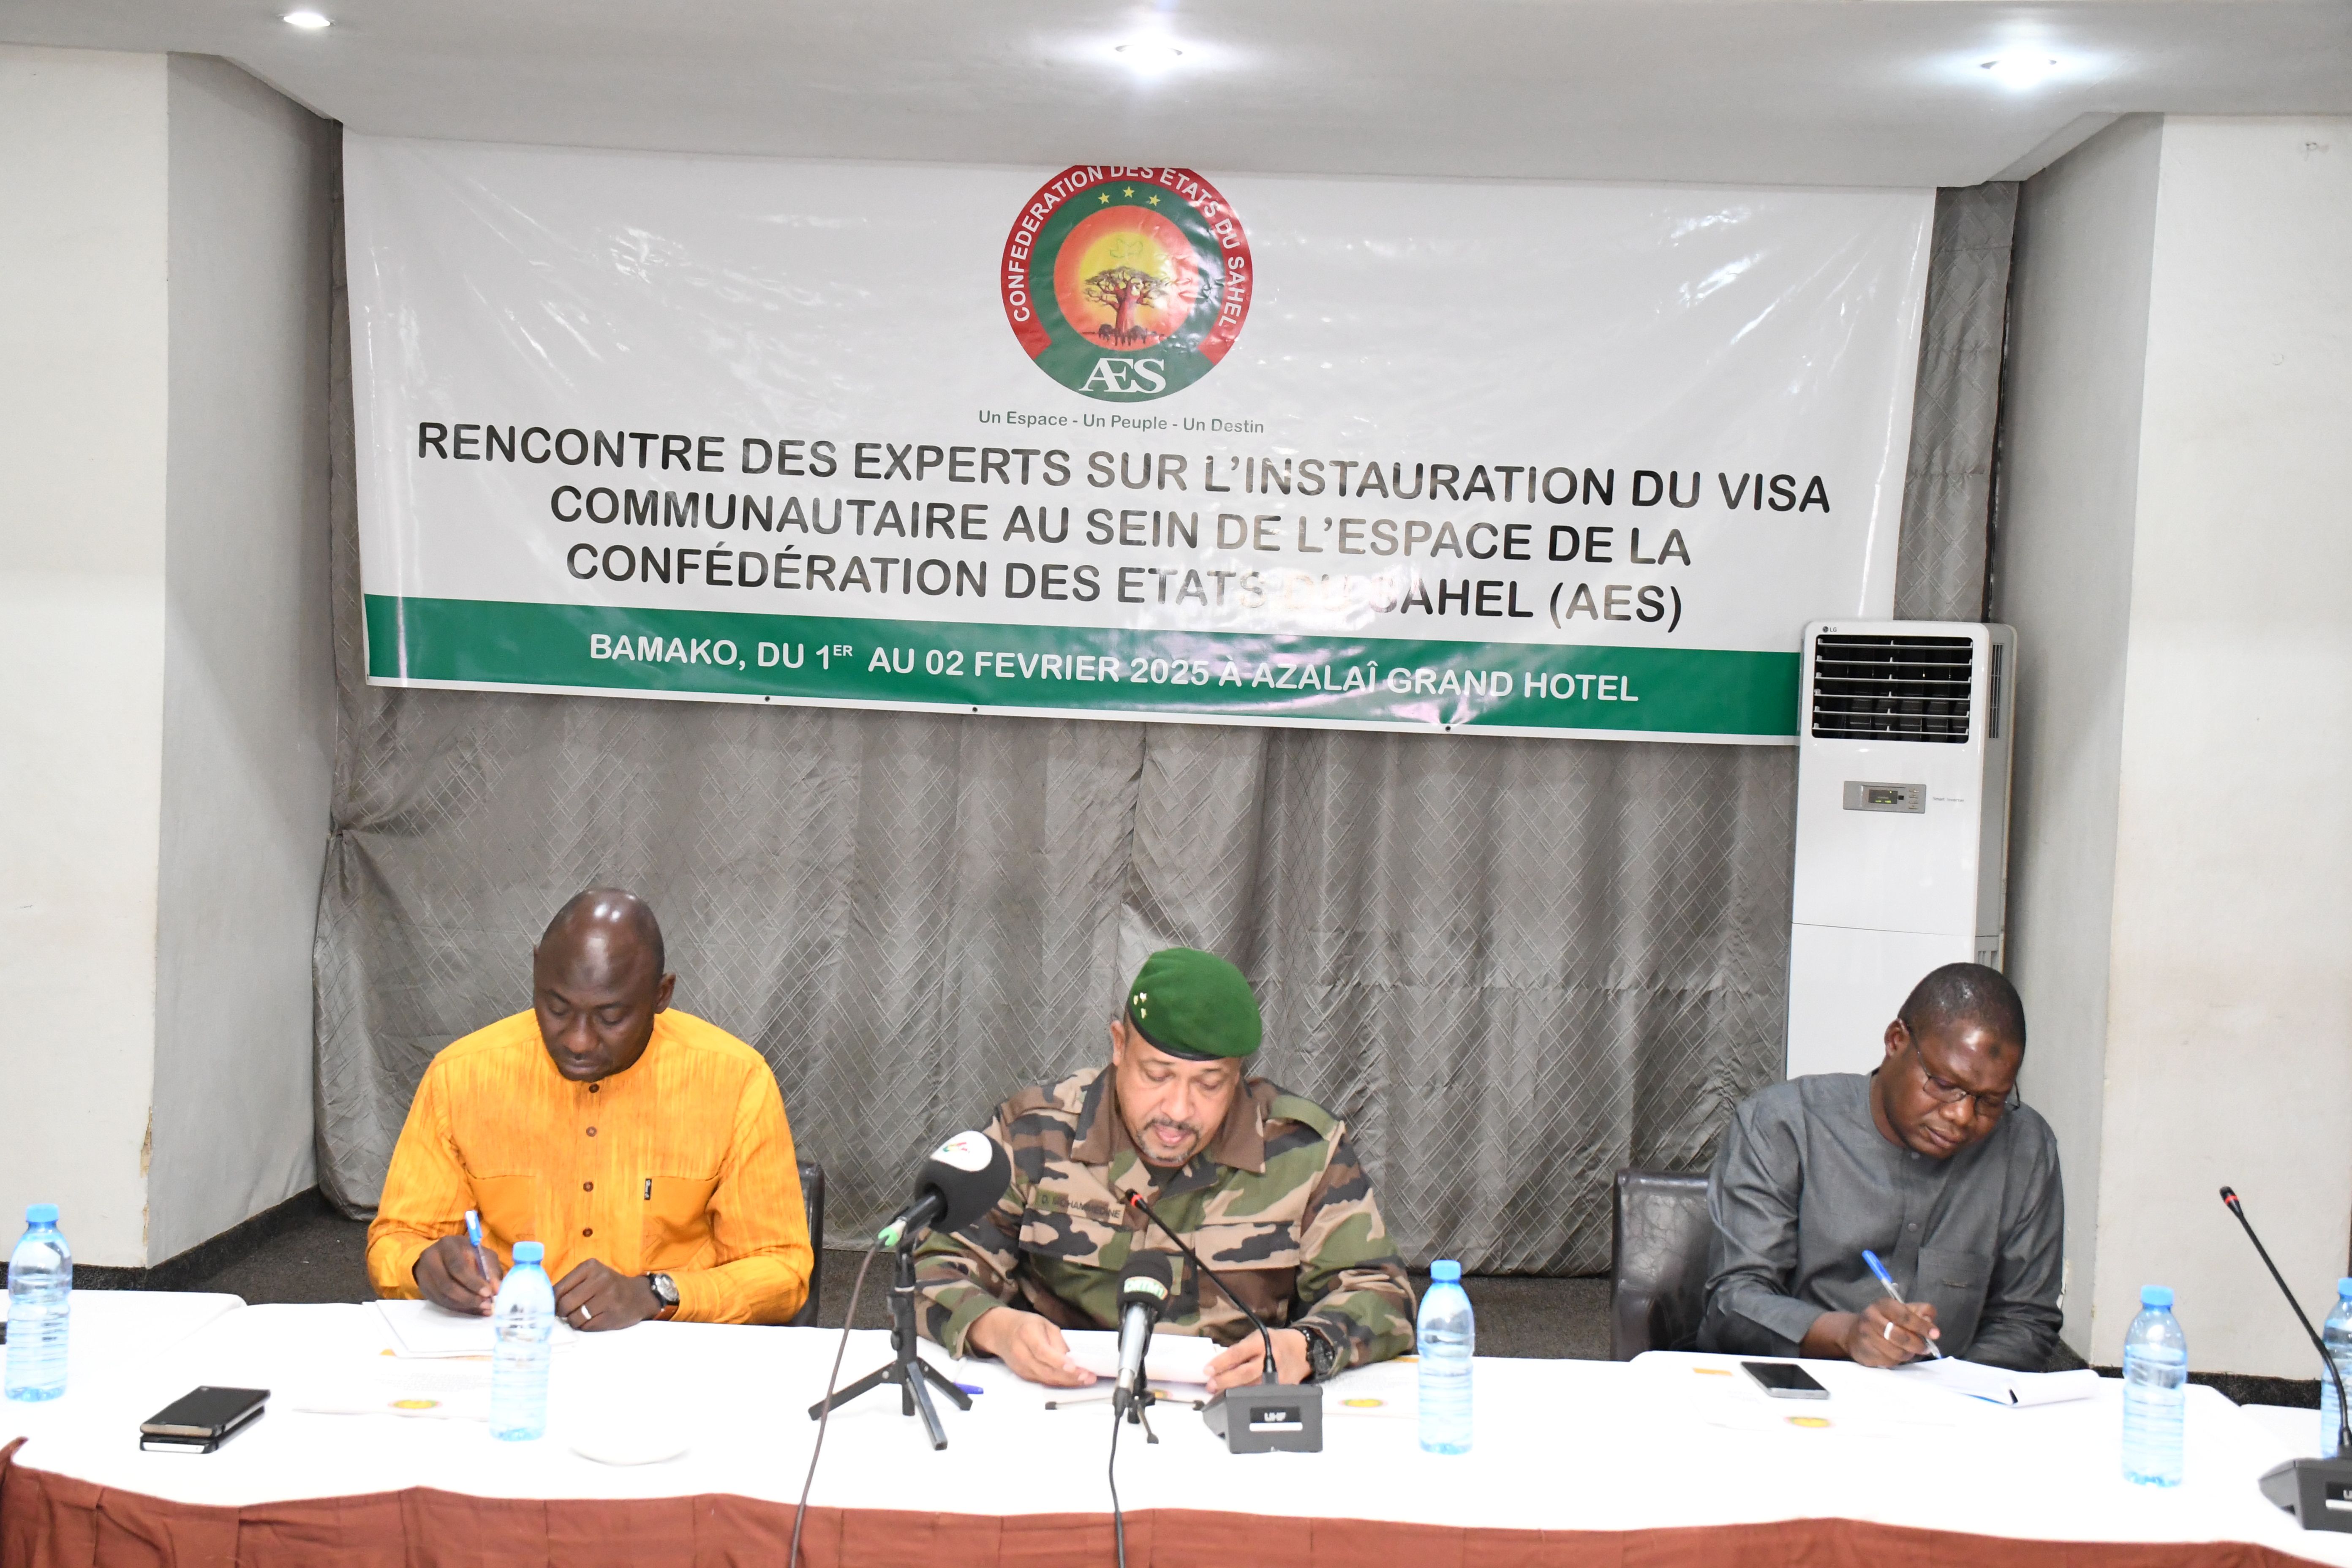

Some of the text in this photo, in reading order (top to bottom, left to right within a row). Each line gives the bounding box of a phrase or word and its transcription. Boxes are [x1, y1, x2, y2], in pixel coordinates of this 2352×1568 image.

[1160, 167, 1221, 218] ETATS
[1008, 166, 1103, 322] CONFEDERATION
[1215, 218, 1240, 249] DU
[1218, 256, 1245, 327] SAHEL
[979, 410, 1001, 424] Un
[1007, 411, 1067, 428] Espace
[1083, 414, 1105, 427] Un
[1111, 415, 1168, 430] Peuple
[1183, 417, 1206, 431] Un
[1211, 419, 1264, 433] Destin
[419, 422, 1830, 513] RENCONTRE DES EXPERTS SUR L'INSTAURATION DU VISA
[551, 485, 1691, 566] COMMUNAUTAIRE AU SEIN DE L'ESPACE DE LA
[567, 541, 987, 597] CONFÉDÉRATION
[1005, 563, 1100, 602] DES
[1118, 567, 1266, 608] ETATS
[1369, 578, 1533, 618] SAHEL
[1550, 582, 1681, 633] (AES)
[591, 633, 746, 671] BAMAKO,
[758, 642, 804, 668] DU
[868, 647, 913, 674] AU
[926, 649, 964, 676] 02
[975, 651, 1119, 683] FEVRIER
[1130, 658, 1209, 686] 2025
[1219, 656, 1242, 687] À
[1252, 661, 1377, 694] AZALAÎ
[1387, 667, 1513, 697] GRAND
[1524, 672, 1639, 701] HOTEL
